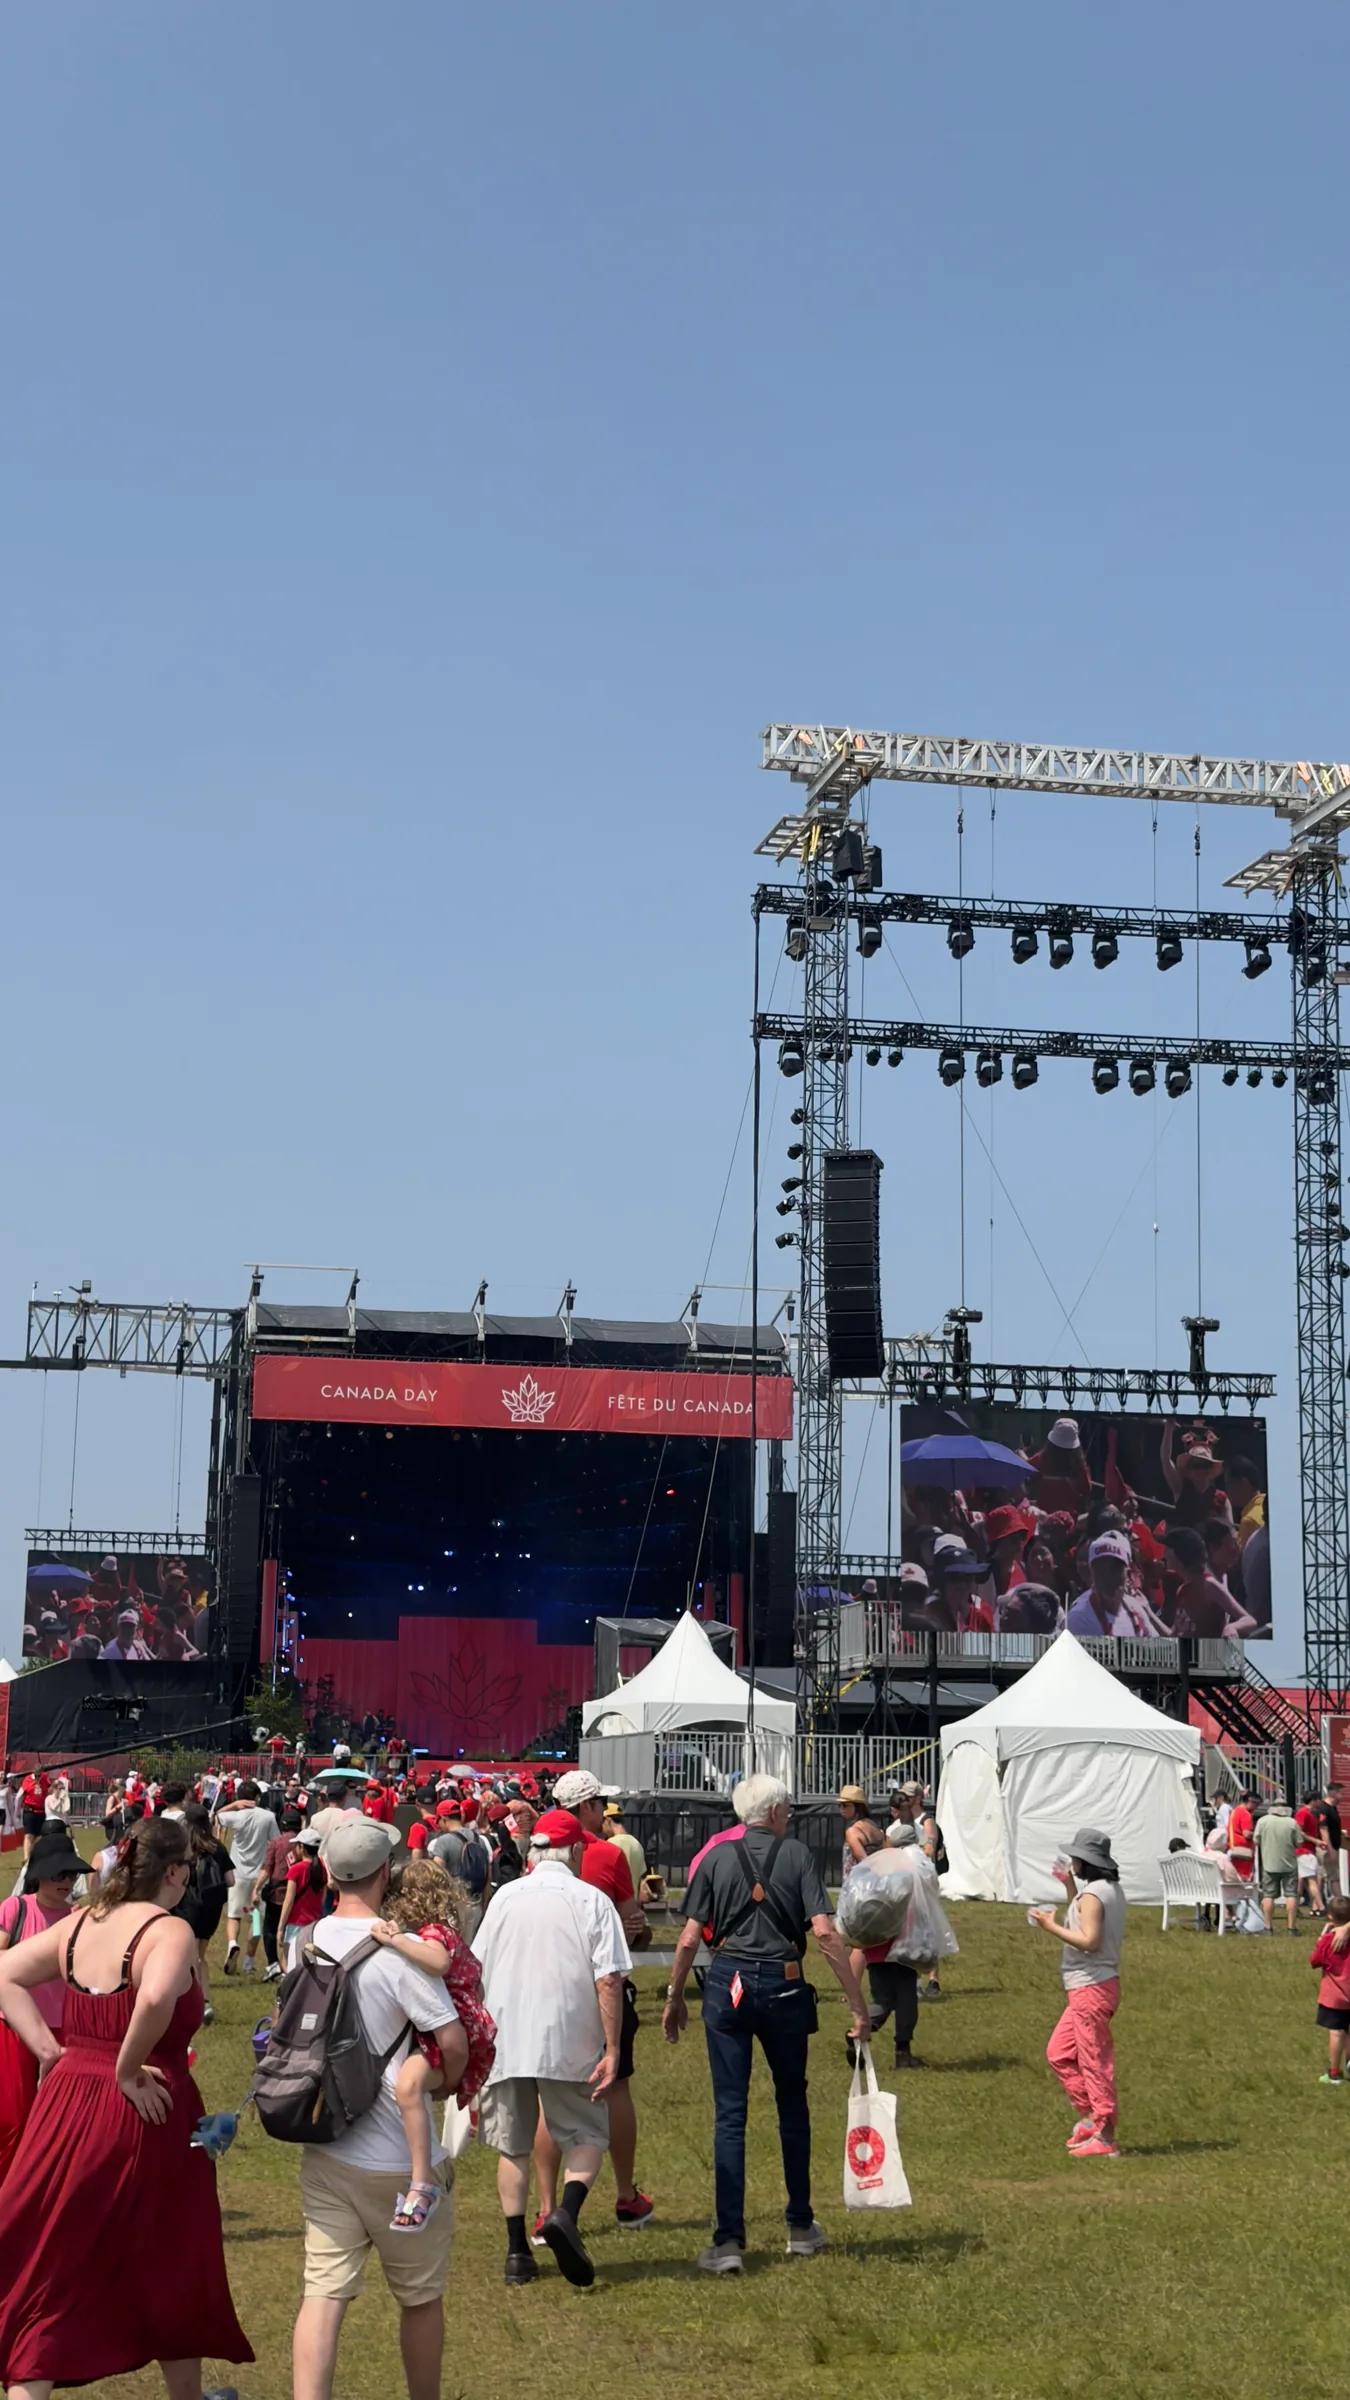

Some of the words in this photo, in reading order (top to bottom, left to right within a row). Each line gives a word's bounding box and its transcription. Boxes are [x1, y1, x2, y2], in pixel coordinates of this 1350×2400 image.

[321, 1385, 397, 1400] CANADA
[404, 1388, 438, 1402] DAY
[608, 1394, 646, 1410] FÊTE
[654, 1398, 676, 1412] DU
